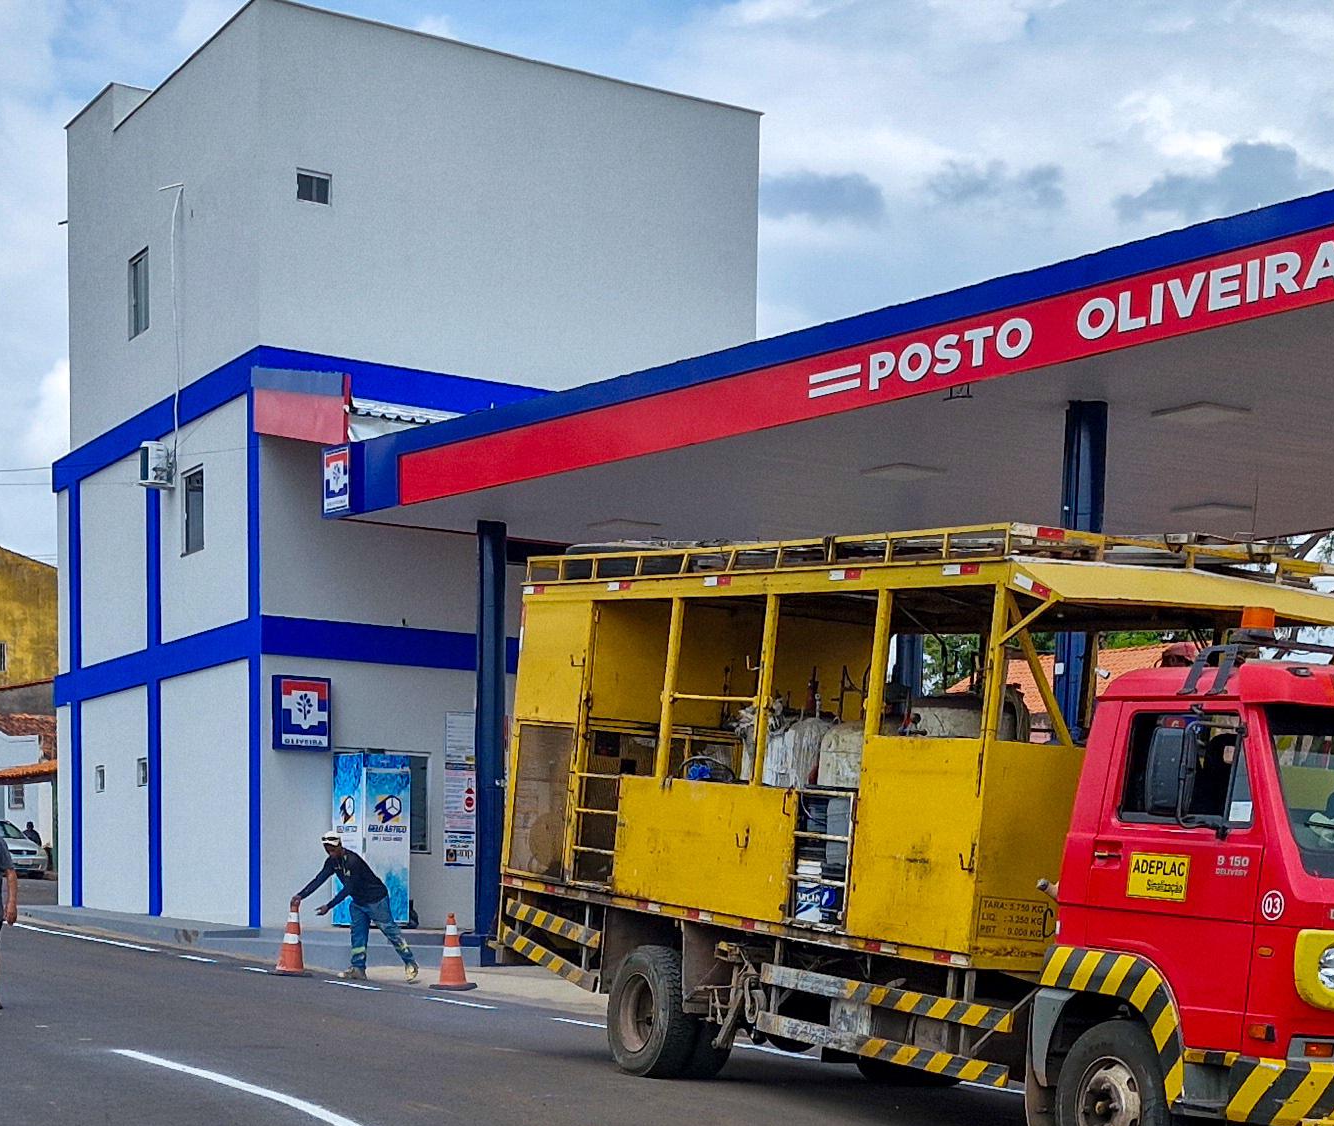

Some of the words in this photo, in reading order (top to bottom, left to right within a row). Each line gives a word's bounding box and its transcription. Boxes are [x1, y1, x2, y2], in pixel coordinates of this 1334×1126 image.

[869, 317, 1033, 391] POSTO
[284, 738, 323, 746] OLIVEIRA
[1132, 859, 1186, 877] ADEPLAC
[1215, 868, 1249, 878] DELIVERY
[1032, 905, 1044, 914] KG
[1264, 897, 1281, 915] 03
[1030, 917, 1043, 926] KG
[1030, 930, 1042, 938] KG
